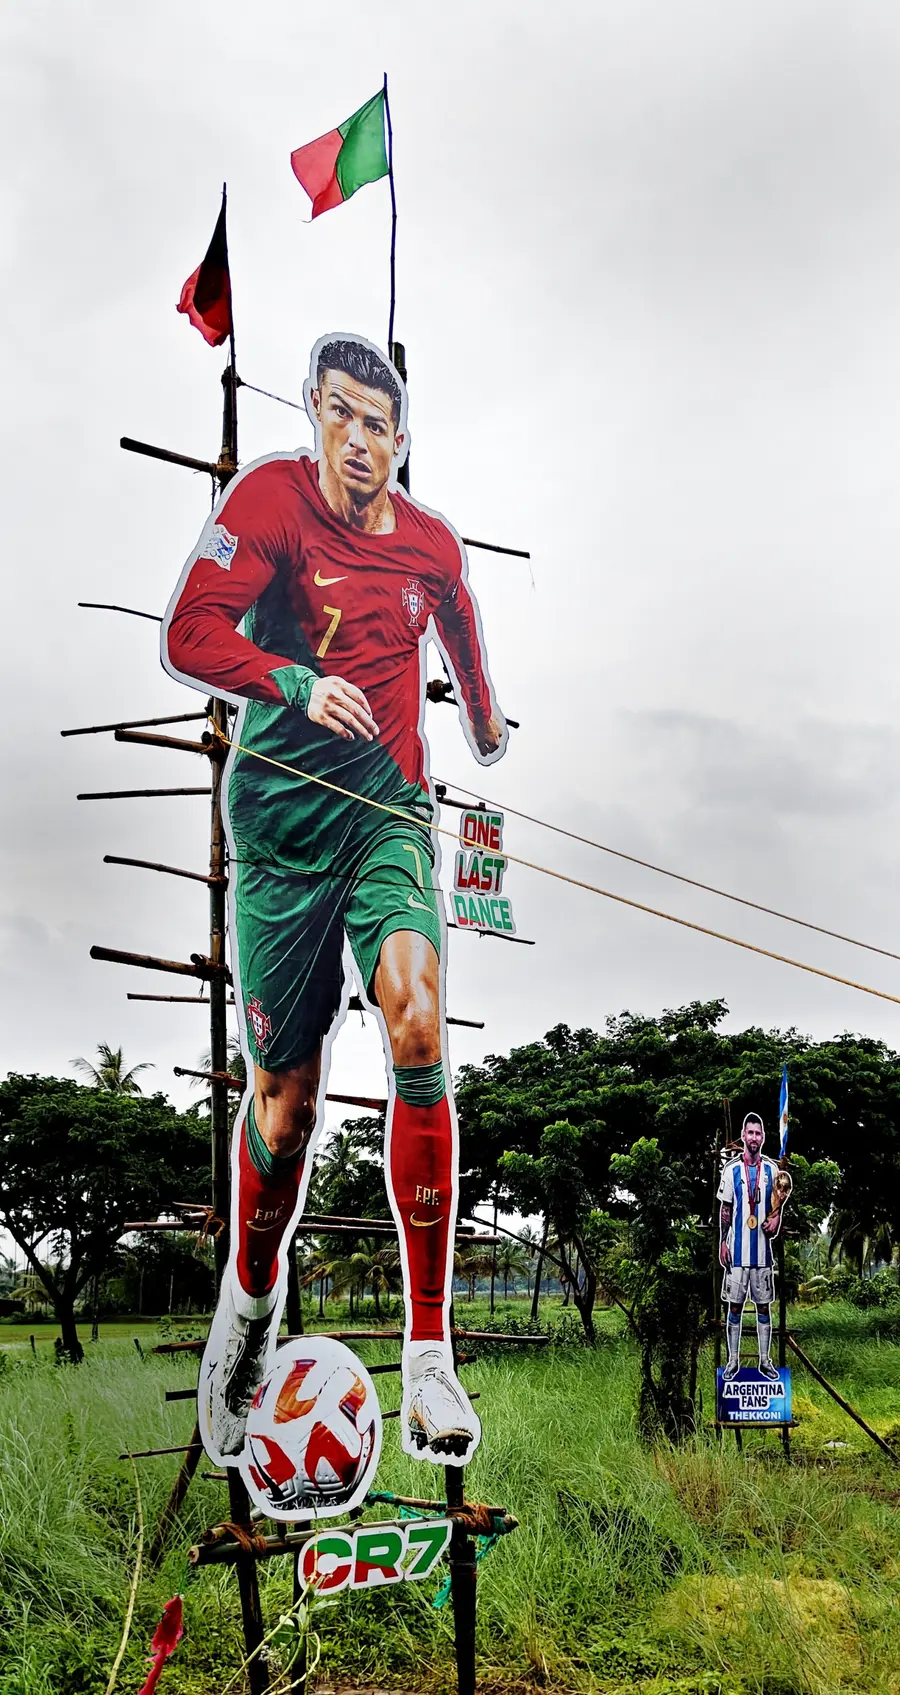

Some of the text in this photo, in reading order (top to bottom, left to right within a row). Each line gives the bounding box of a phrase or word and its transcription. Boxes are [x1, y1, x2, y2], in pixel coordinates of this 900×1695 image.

[316, 604, 342, 659] 7
[463, 812, 502, 851] ONE
[457, 854, 505, 892] LAST
[453, 894, 513, 931] DANCE
[725, 1384, 784, 1396] ARGENTINA
[741, 1396, 768, 1408] FANS
[727, 1411, 781, 1420] THEKKONI
[302, 1524, 449, 1590] CR7
